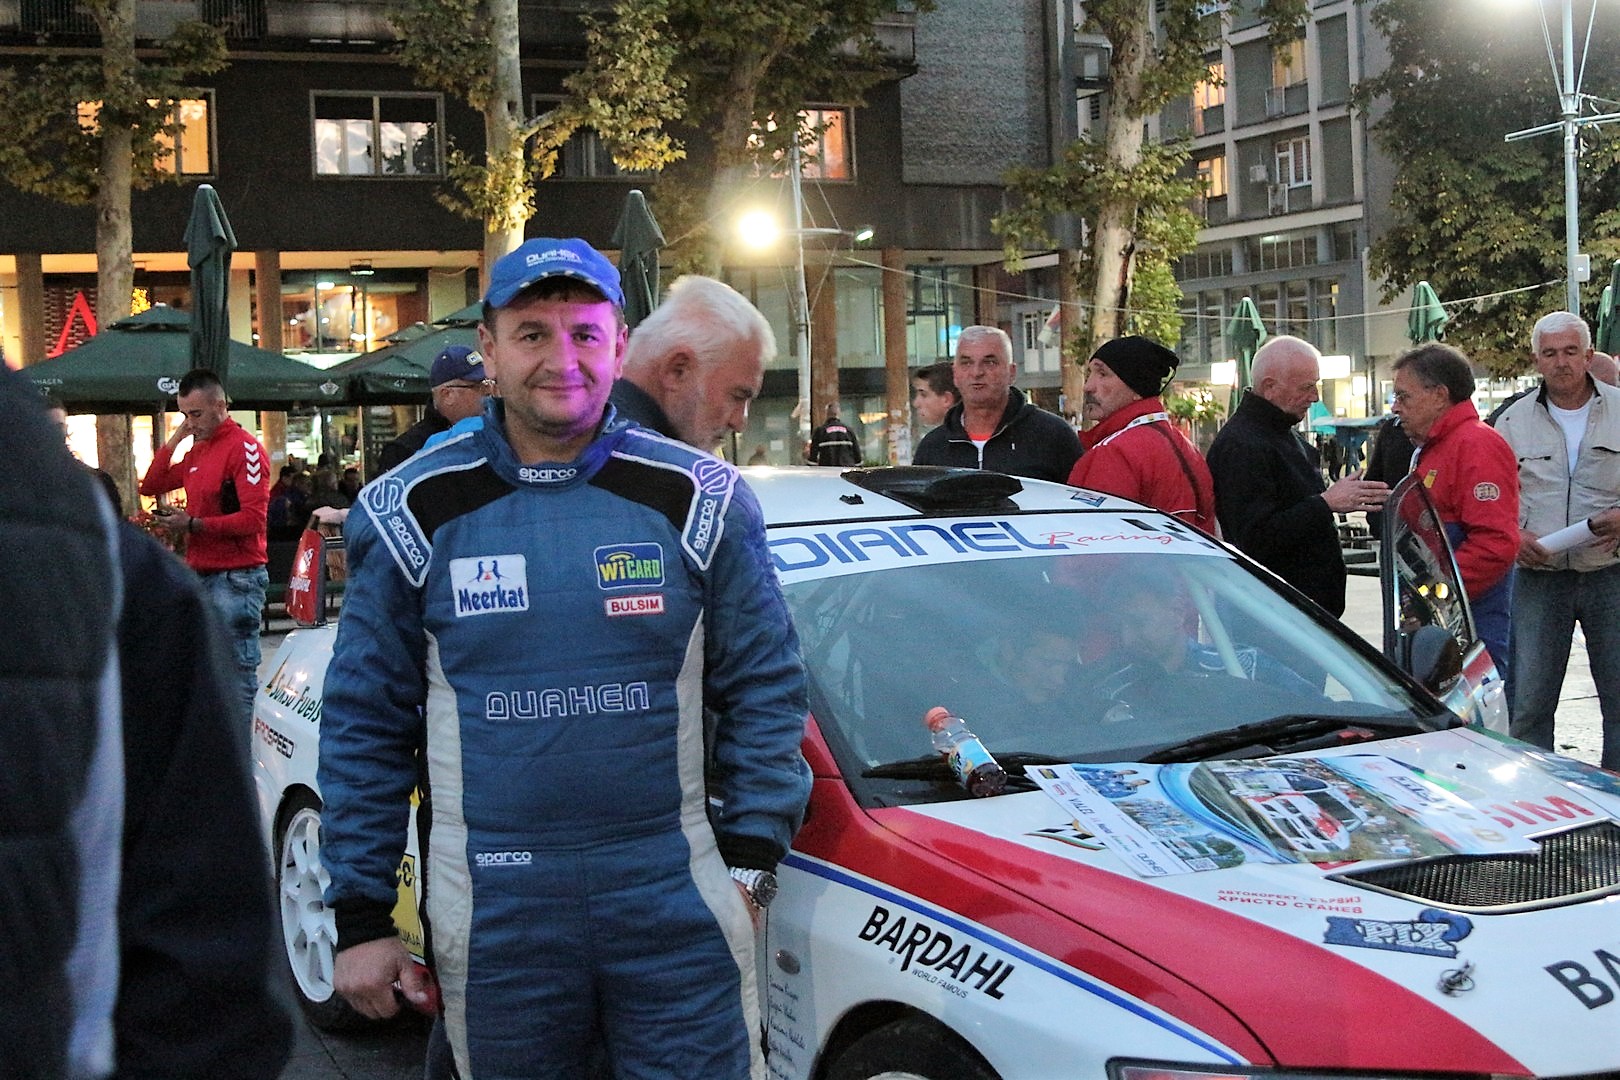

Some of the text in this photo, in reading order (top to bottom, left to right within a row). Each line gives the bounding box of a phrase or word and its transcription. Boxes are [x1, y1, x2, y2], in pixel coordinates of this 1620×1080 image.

[519, 467, 577, 483] sparco
[694, 498, 717, 551] sparco
[388, 515, 426, 569] sparco
[766, 521, 1173, 572] DIANEL Racing
[458, 584, 526, 613] Meerkat
[611, 598, 660, 613] BULSIM
[291, 686, 322, 723] Fuels
[475, 851, 533, 867] sparco
[1217, 895, 1363, 914] ХРИСТО СТАНЕВ
[858, 905, 1015, 1000] BARDAHL
[911, 967, 969, 999] WORLD FAMOUS
